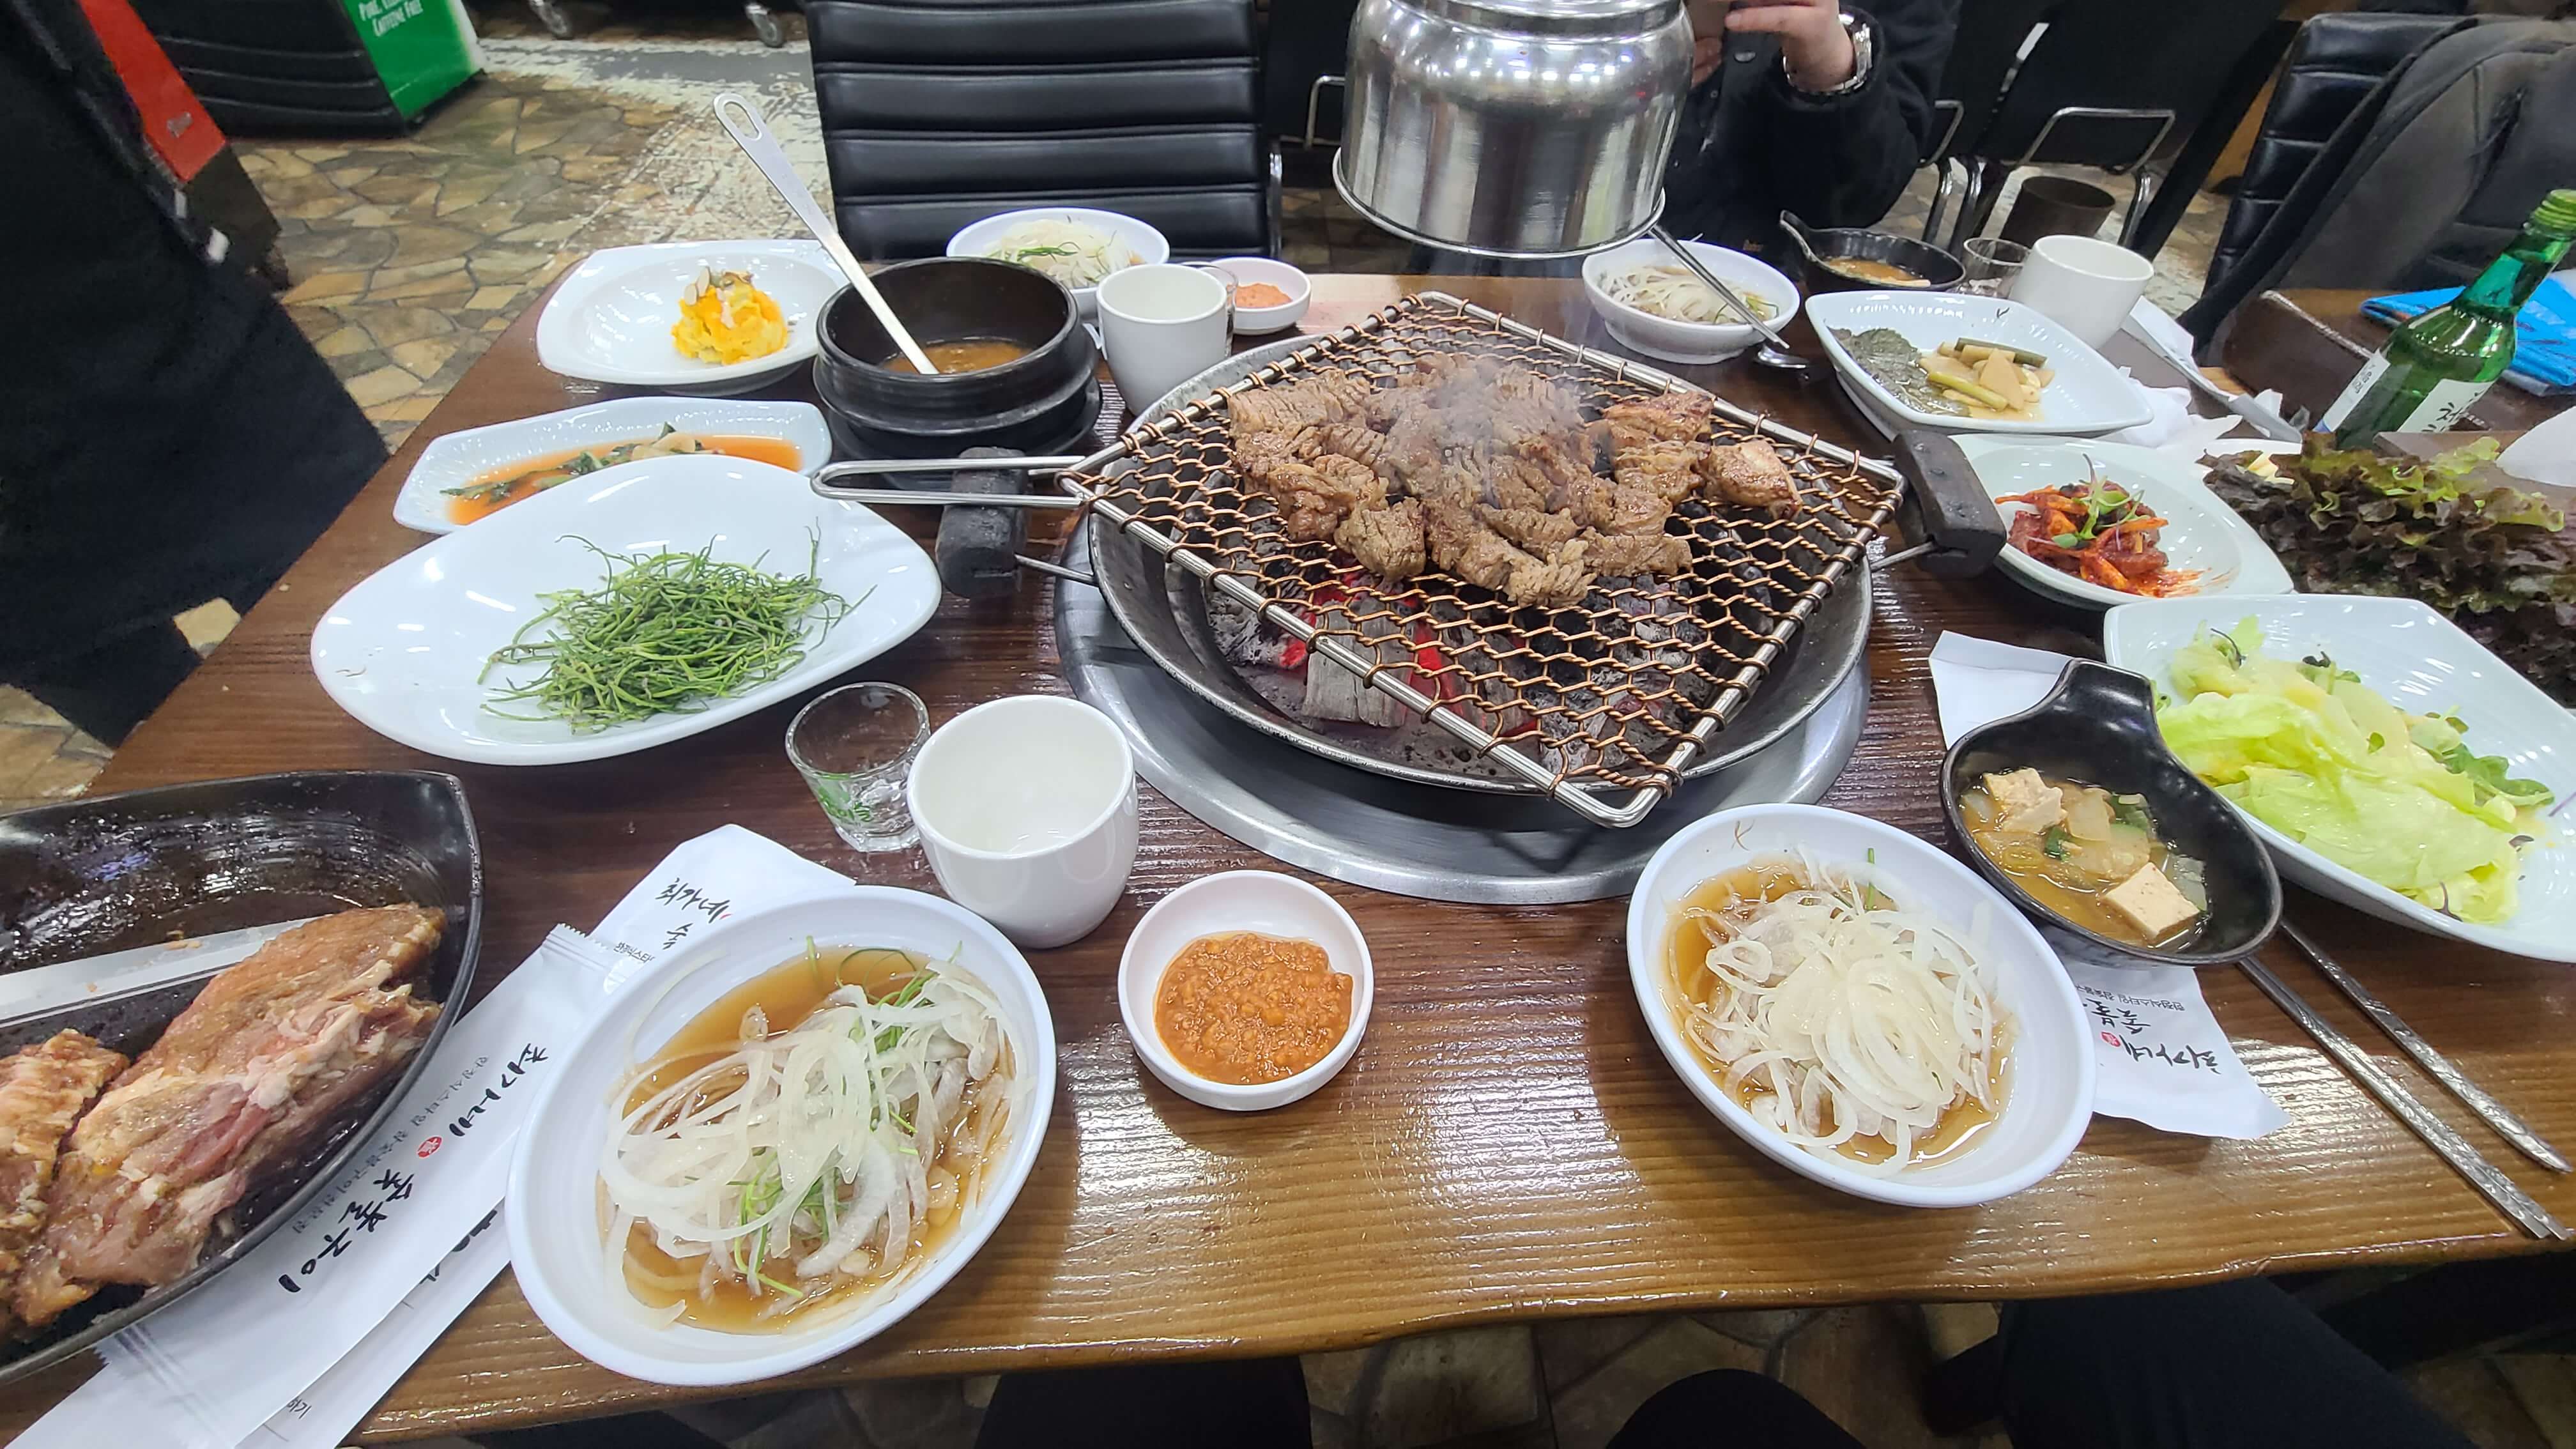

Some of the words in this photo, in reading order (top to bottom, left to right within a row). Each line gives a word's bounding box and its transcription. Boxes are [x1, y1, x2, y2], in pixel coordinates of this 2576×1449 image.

[655, 877, 730, 923] 최가네
[613, 942, 655, 963] 한정식스타
[2082, 997, 2151, 1034] 숯불
[2118, 994, 2185, 1011] 한정식스타일
[2119, 1034, 2221, 1075] 최가네
[411, 1055, 488, 1126] 한정식스타일
[449, 1043, 548, 1137] 최가네
[278, 1169, 415, 1293] 숯불구이
